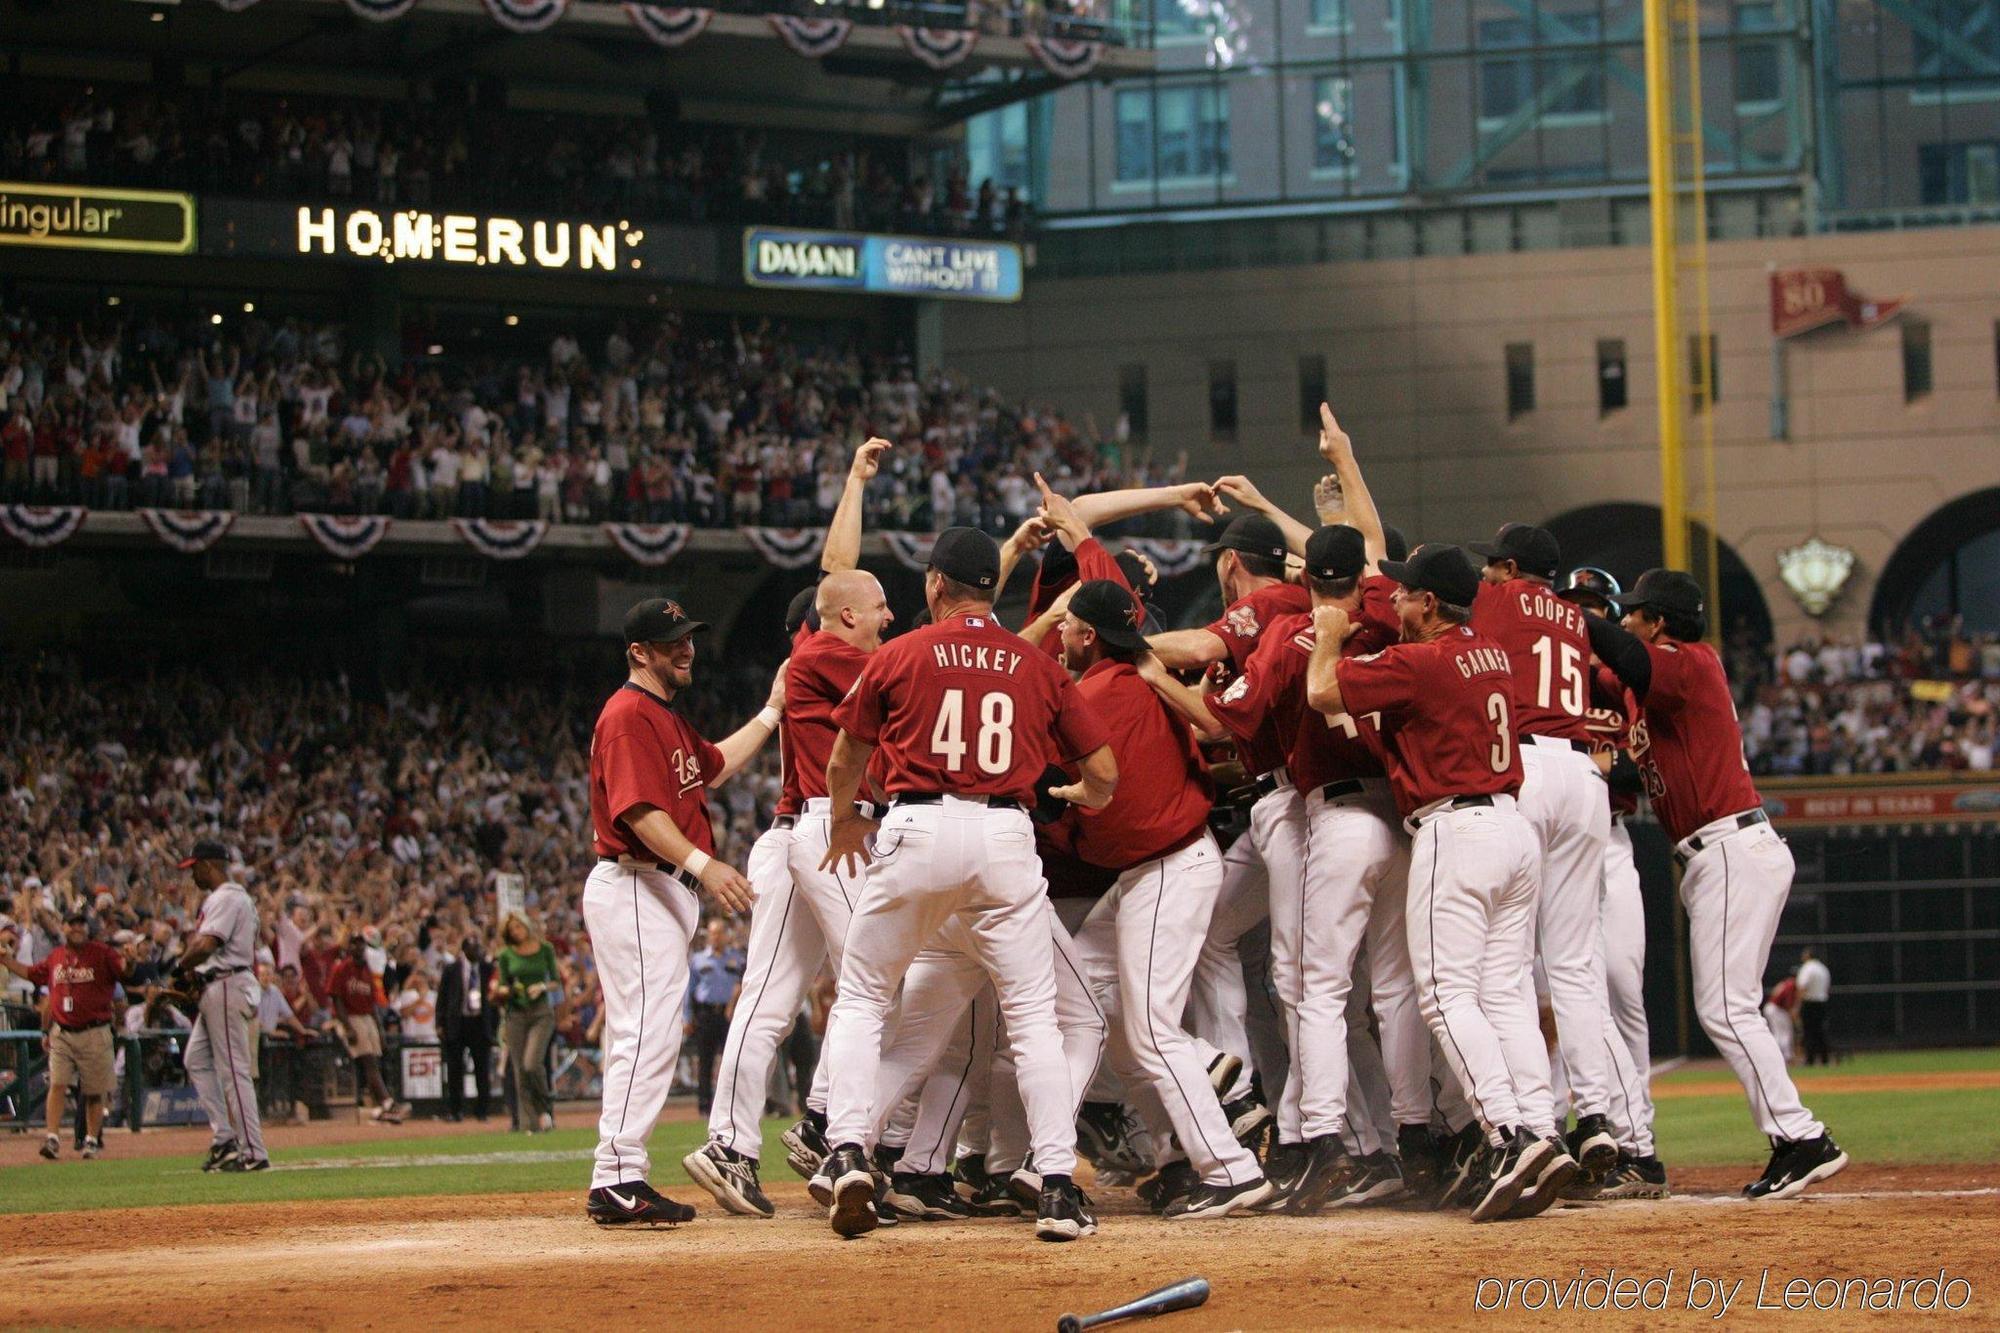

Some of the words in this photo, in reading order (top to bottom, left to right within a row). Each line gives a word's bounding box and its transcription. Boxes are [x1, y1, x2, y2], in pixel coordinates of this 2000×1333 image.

[0, 195, 115, 237] ingular
[758, 240, 856, 278] DASANI
[884, 243, 946, 266] CAN'T
[951, 248, 999, 272] LIVE
[885, 266, 976, 291] WITHOUT
[981, 271, 1000, 292] IT
[1519, 592, 1586, 639] COOPER
[932, 642, 1023, 676] HICKEY
[1531, 635, 1584, 717] 15
[930, 689, 1016, 775] 48
[1486, 692, 1511, 773] 3
